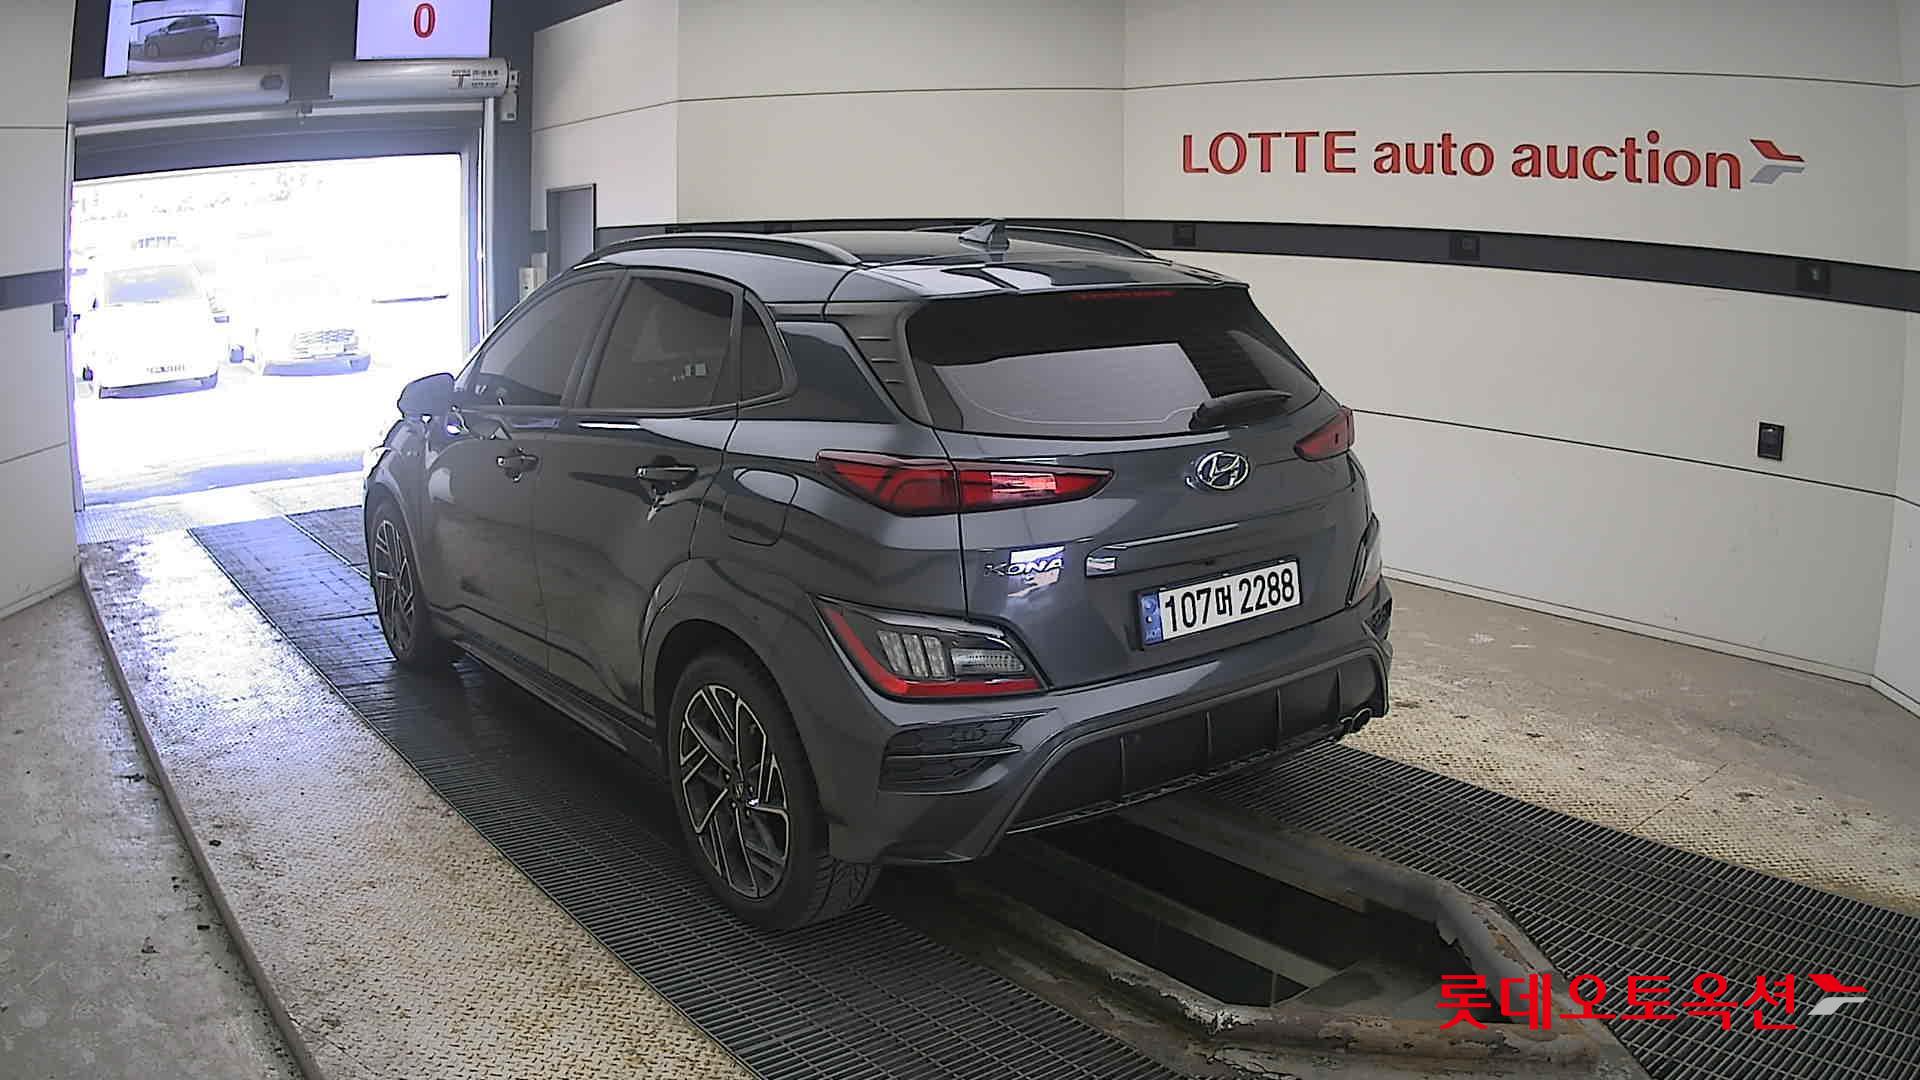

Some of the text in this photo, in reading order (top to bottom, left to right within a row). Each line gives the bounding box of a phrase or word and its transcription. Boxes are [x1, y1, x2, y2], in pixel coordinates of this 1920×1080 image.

[413, 3, 436, 38] 0
[1182, 129, 1742, 190] LOTTE auto auction
[983, 557, 1064, 576] KONA
[1164, 568, 1295, 632] 107머 2288
